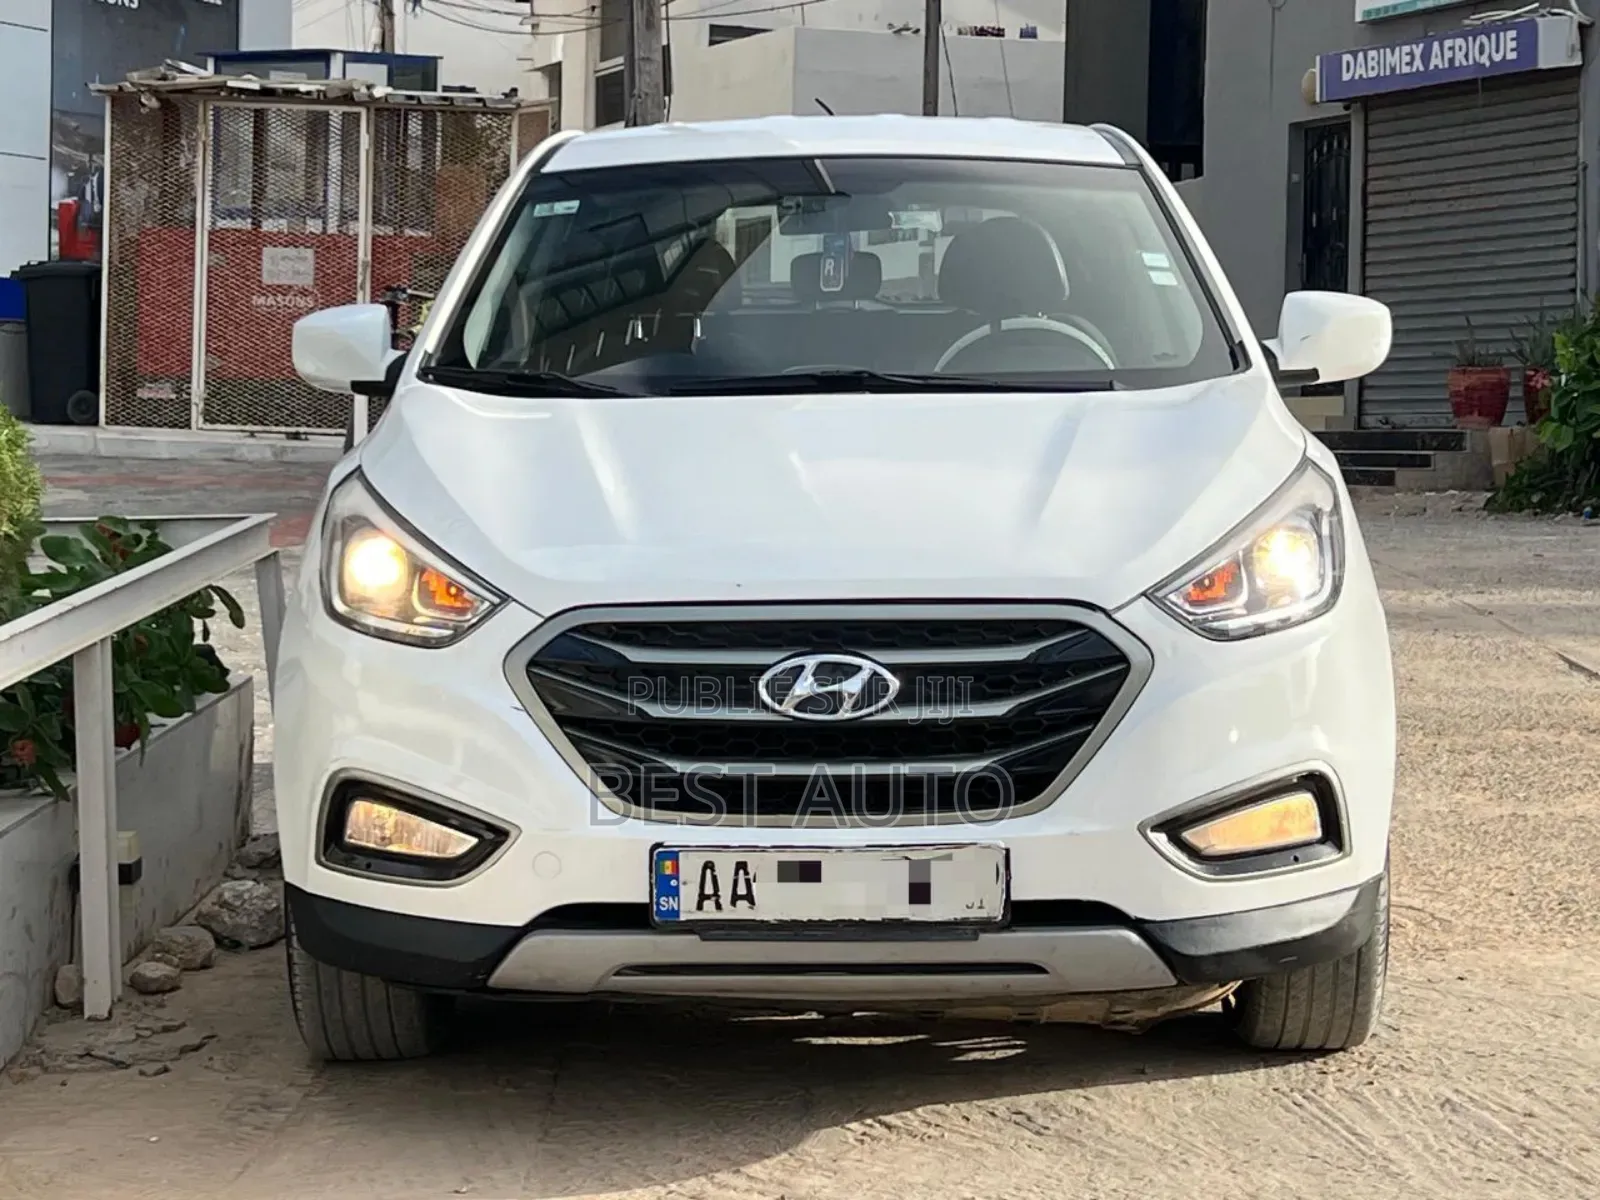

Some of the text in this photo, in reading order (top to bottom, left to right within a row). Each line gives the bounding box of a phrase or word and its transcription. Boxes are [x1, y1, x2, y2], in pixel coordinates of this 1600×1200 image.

[1340, 29, 1518, 82] DABIMEX AFRIQUE
[658, 896, 679, 911] SN
